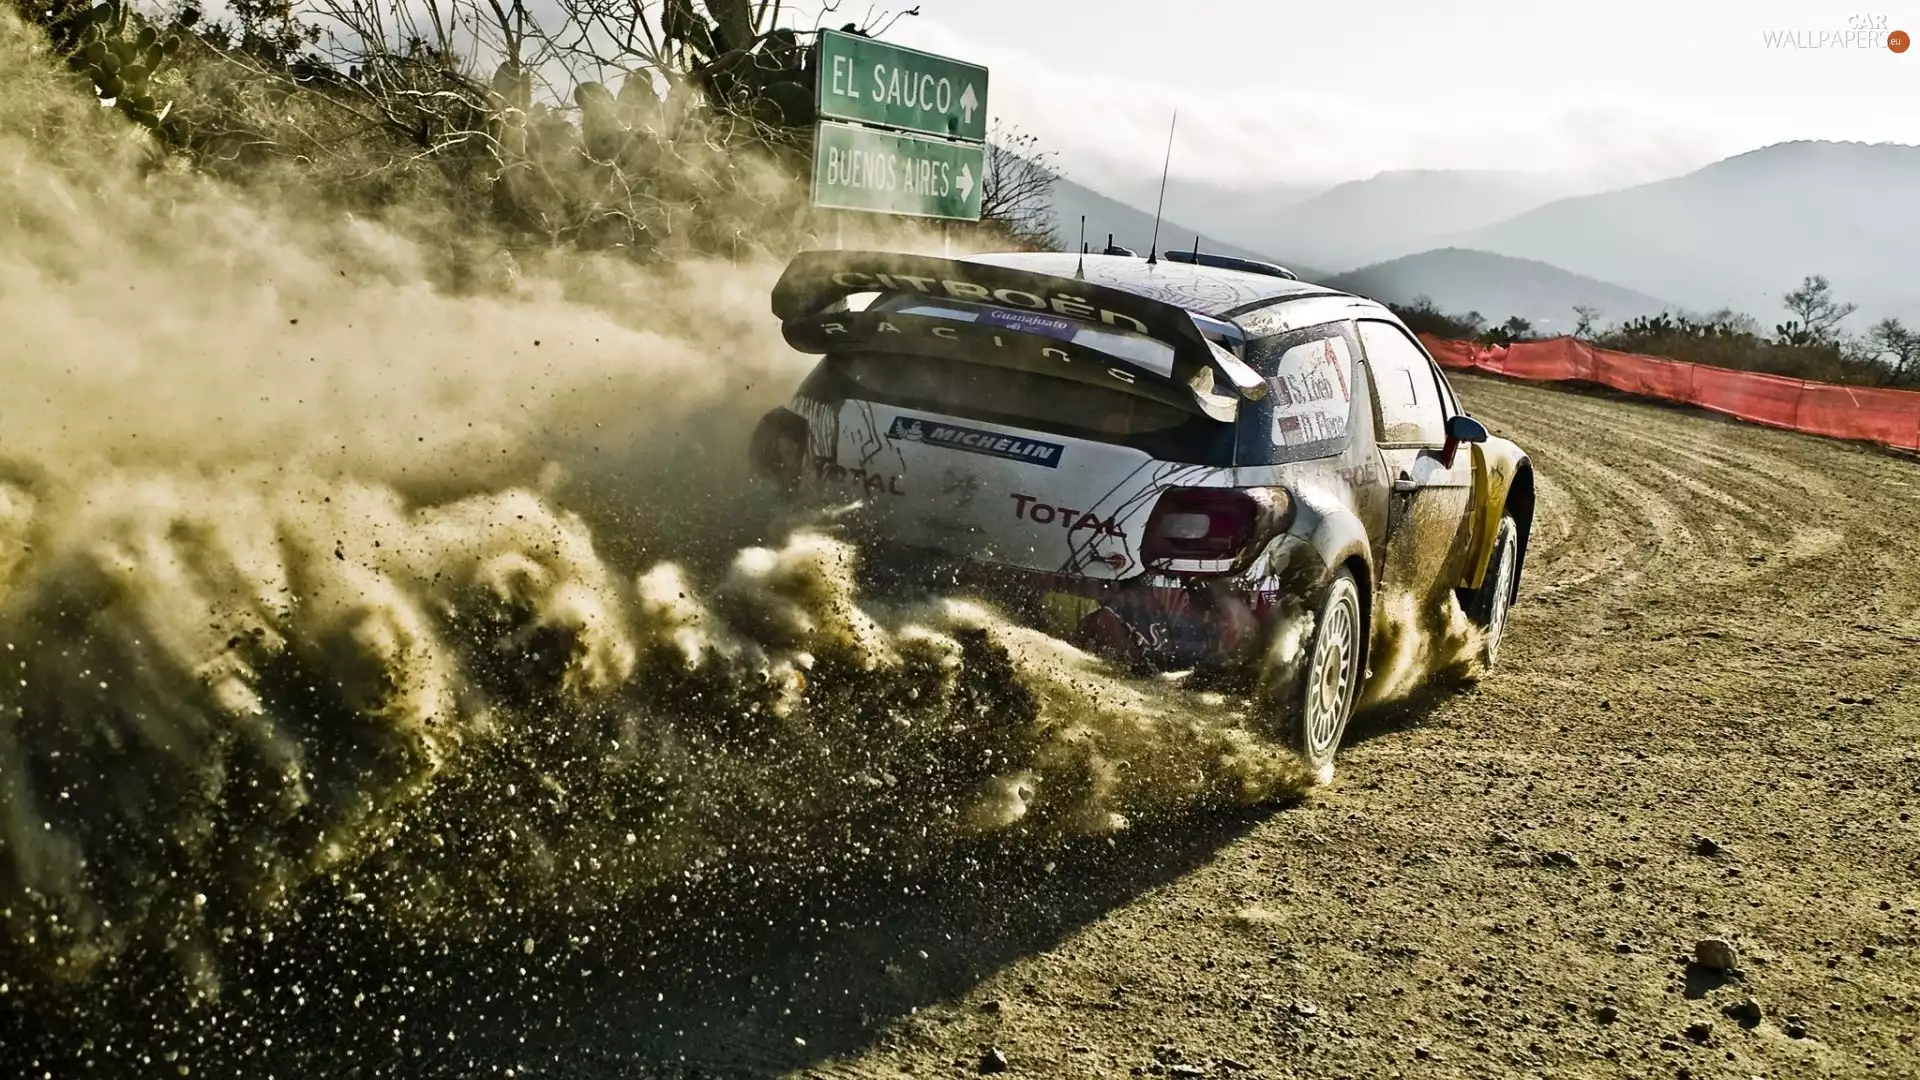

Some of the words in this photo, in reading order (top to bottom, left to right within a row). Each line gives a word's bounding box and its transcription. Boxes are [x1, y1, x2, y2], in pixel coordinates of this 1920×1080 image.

[832, 55, 860, 98] EL
[872, 63, 951, 114] SAUCO
[827, 146, 896, 192] BUENOS
[903, 157, 949, 198] AIRES
[991, 309, 1068, 331] Guanajuato
[821, 321, 1135, 384] RACING
[930, 427, 1055, 460] MICHELIN
[1010, 493, 1127, 538] TOTAL
